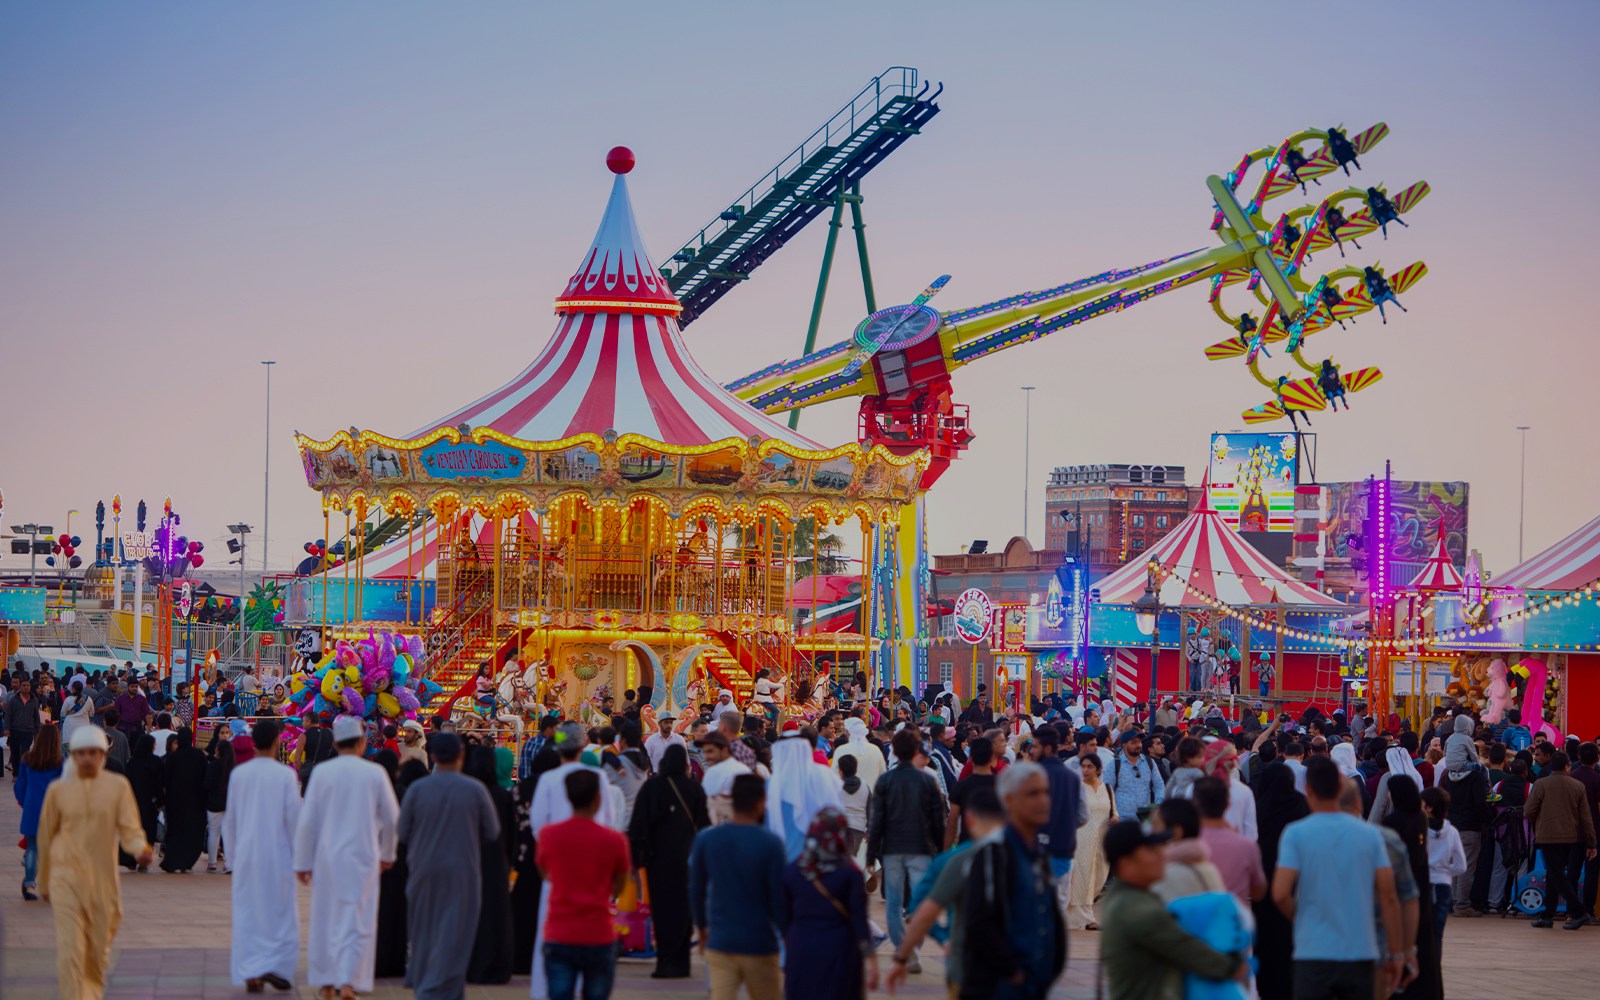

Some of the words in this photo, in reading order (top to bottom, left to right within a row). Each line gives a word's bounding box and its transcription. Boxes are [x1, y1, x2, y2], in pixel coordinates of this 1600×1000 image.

[436, 449, 468, 469] VENETIAN
[468, 448, 508, 469] CAROUSEL
[955, 593, 967, 613] FLY
[967, 590, 991, 623] FRANCE
